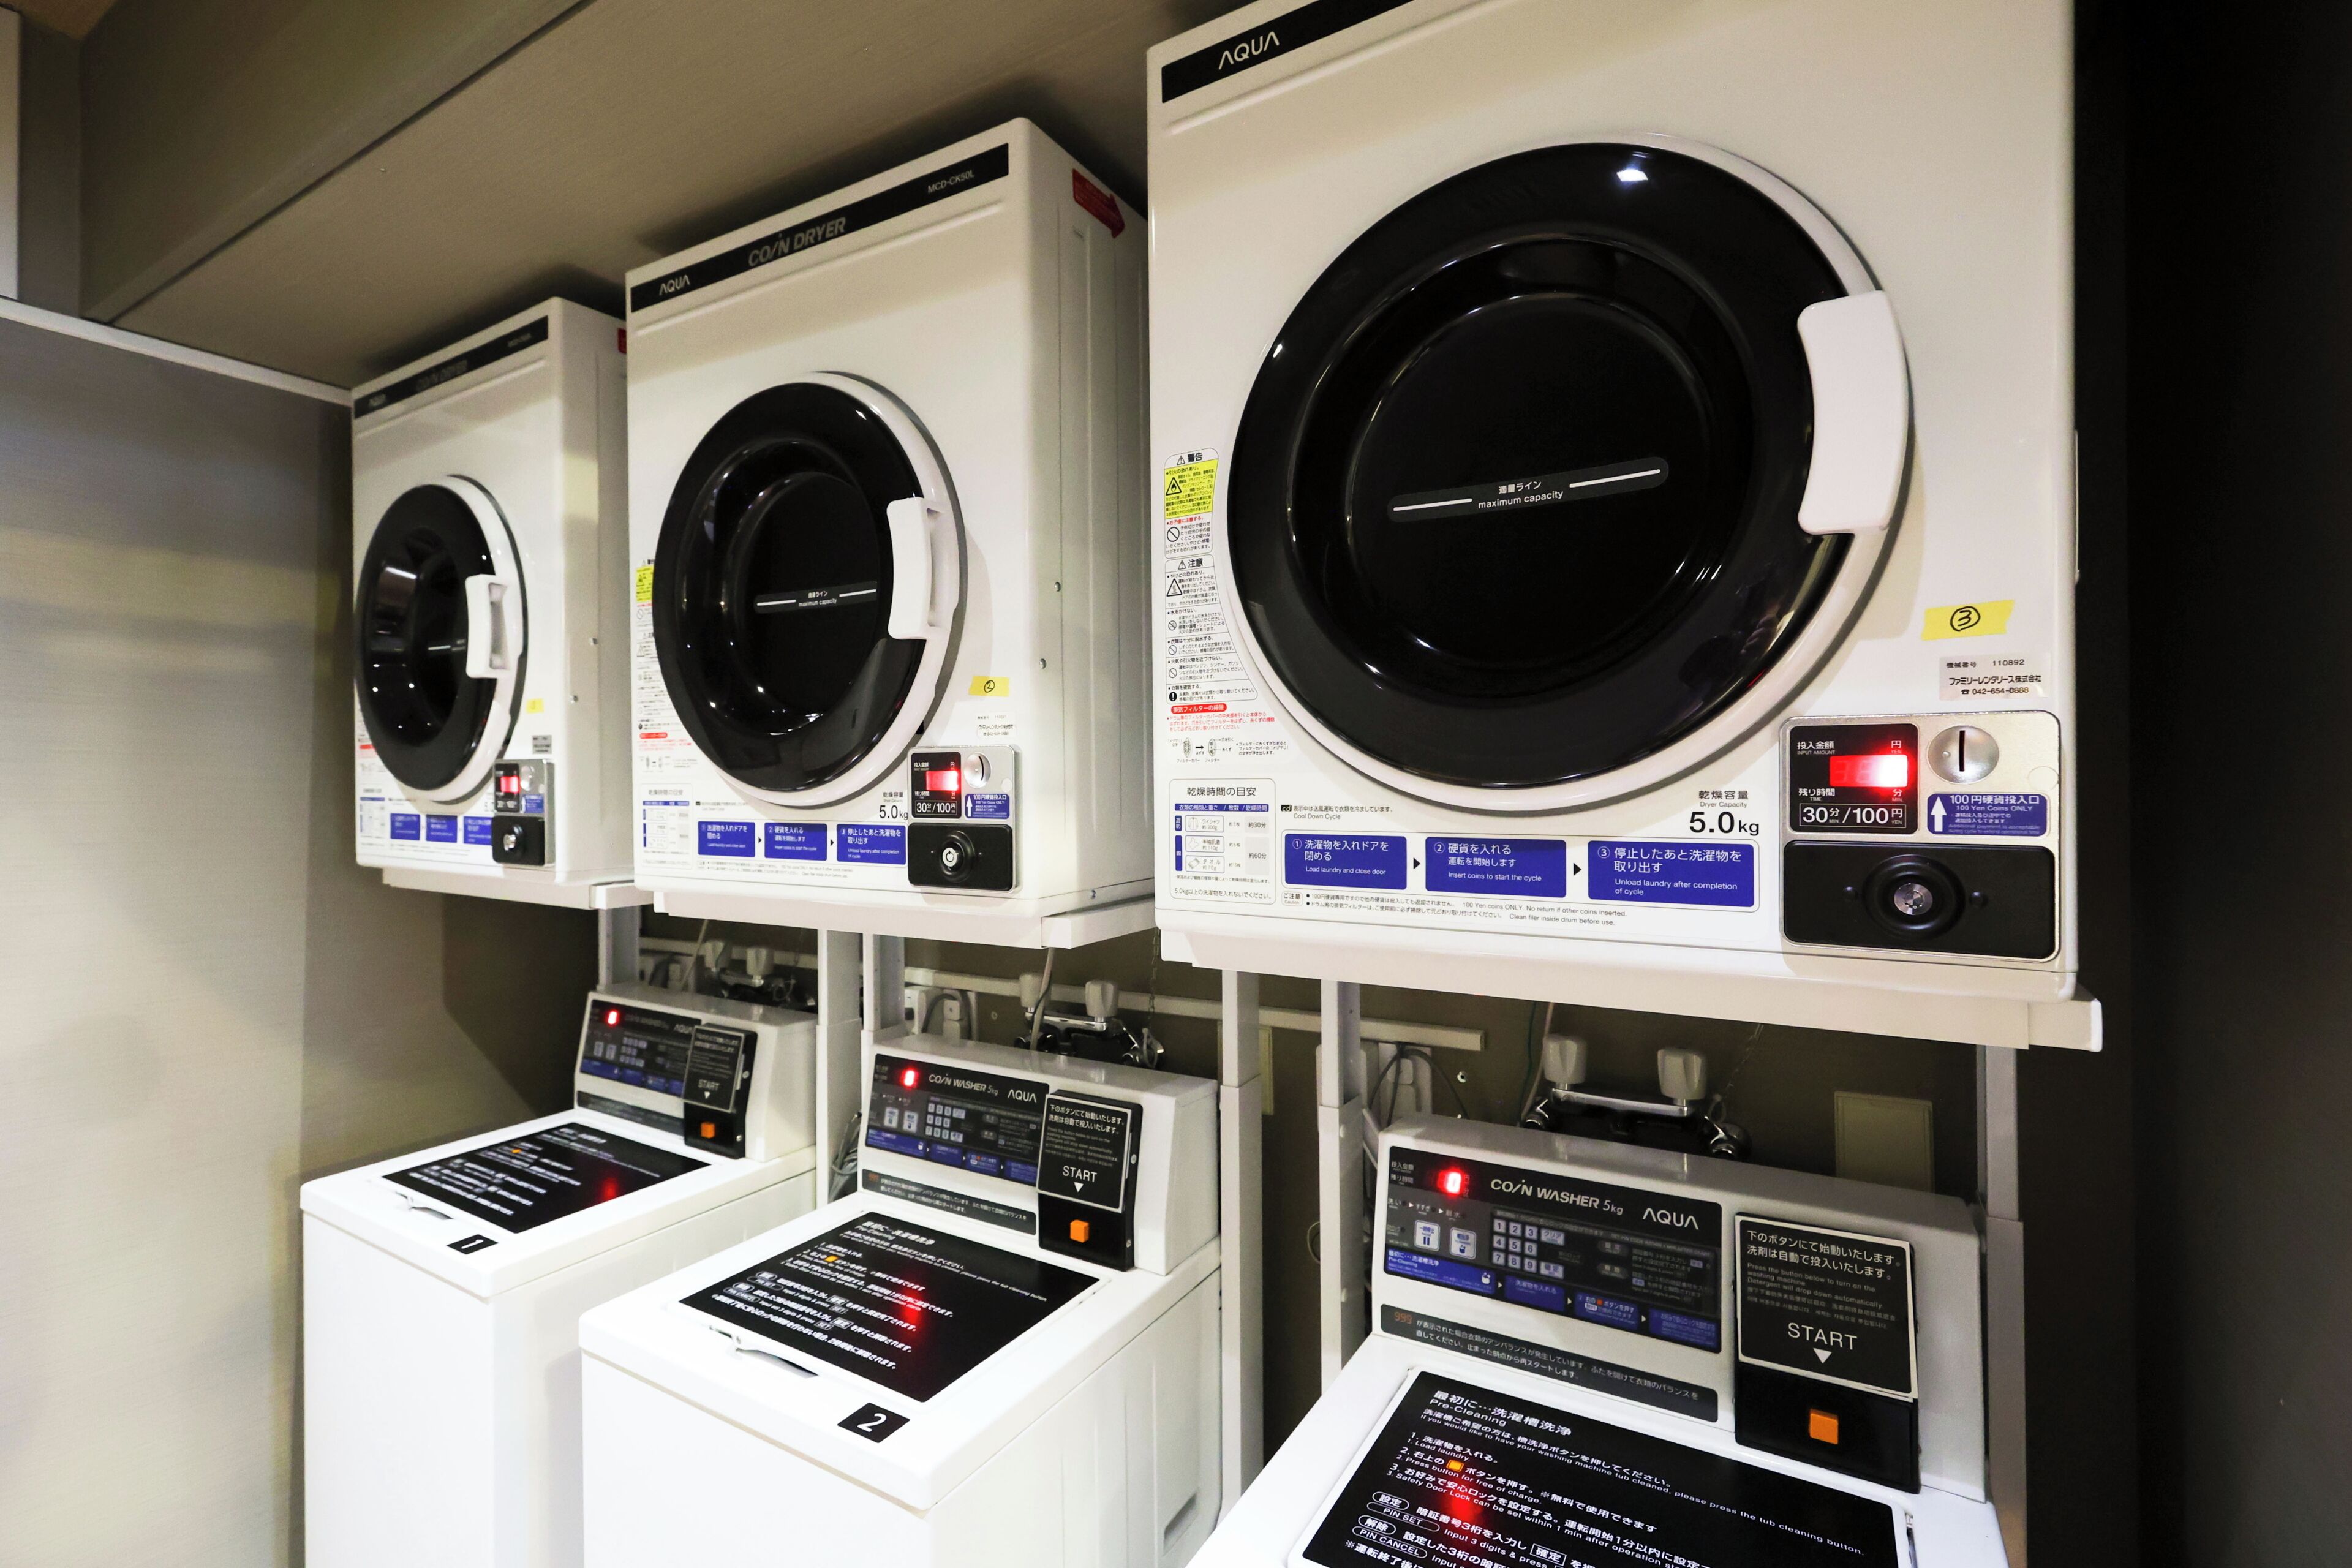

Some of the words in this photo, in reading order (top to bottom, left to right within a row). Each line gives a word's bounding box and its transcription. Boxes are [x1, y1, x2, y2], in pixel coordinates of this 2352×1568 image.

[1219, 31, 1280, 70] AQUA
[794, 217, 846, 251] DRYER
[658, 274, 690, 296] AQUA
[1188, 452, 1202, 462] 警告
[1499, 481, 1541, 494] 適量ライン
[1479, 496, 1521, 509] maximum
[1524, 490, 1564, 505] capacity
[1188, 558, 1203, 567] 注意
[1797, 741, 1834, 750] 投入金額
[1891, 740, 1901, 748] 円
[1187, 787, 1256, 796] 乾燥時間の目安
[1699, 791, 1749, 800] 乾燥容量
[1305, 840, 1389, 851] 洗濯物を入れドアを
[1449, 843, 1512, 854] 硬貨を入れる
[1305, 851, 1332, 861] 閉める
[1449, 857, 1516, 867] 運転を開始します
[1615, 848, 1742, 862] 停止したあと洗濯物を
[1614, 861, 1662, 873] 取り出す
[1693, 882, 1738, 891] completion
[698, 1079, 720, 1091] START
[954, 1079, 986, 1092] WASHER
[1008, 1089, 1036, 1103] AQUA
[1063, 1166, 1097, 1182] START
[1537, 1188, 1599, 1209] WASHER
[1603, 1200, 1623, 1215] 5kg
[1643, 1208, 1698, 1230] AQUA
[461, 1239, 484, 1249] 1
[1747, 1229, 1901, 1267] 下のボタンにて始動いたします。
[1747, 1244, 1891, 1280] 洗剤は自動で投入いたします。
[1788, 1322, 1858, 1350] START
[1430, 1398, 1507, 1427] Pre-Cleaning
[858, 1413, 886, 1432] 2
[1415, 1441, 1436, 1450] Load
[1422, 1436, 1498, 1463] 洗濯物を入れる。
[1405, 1457, 1430, 1468] Press
[1431, 1464, 1459, 1477] button
[1476, 1479, 1494, 1489] free
[1507, 1488, 1542, 1504] charge.
[1414, 1451, 1445, 1464] 右上の
[1465, 1467, 1533, 1493] ボタンを押す。
[1404, 1468, 1558, 1523] お好みで安心ロックを設定する。
[1444, 1422, 1468, 1431] would
[1495, 1436, 1515, 1446] have
[1517, 1443, 1536, 1452] your
[1537, 1449, 1572, 1464] washing
[1575, 1461, 1612, 1476] machine
[1675, 1491, 1706, 1505] please
[1709, 1502, 1737, 1515] press
[1740, 1511, 1756, 1520] the
[1760, 1518, 1776, 1526] tub
[1779, 1523, 1823, 1543] cleaning
[1827, 1539, 1864, 1556] button.
[1364, 1518, 1389, 1531] 解除
[1378, 1494, 1403, 1507] 設定
[1416, 1506, 1527, 1550] 暗証番号3桁を入力し
[1536, 1547, 1562, 1562] 確定
[1396, 1473, 1423, 1486] Safety
[1426, 1483, 1447, 1493] Door
[1450, 1491, 1471, 1501] Lock
[1473, 1498, 1490, 1508] can
[1525, 1517, 1552, 1529] within
[1564, 1528, 1582, 1539] min
[1586, 1536, 1609, 1547] after
[1611, 1545, 1661, 1566] operation
[1383, 1509, 1401, 1518] PIN
[1403, 1515, 1423, 1526] SET
[1444, 1529, 1468, 1542] Input
[1480, 1542, 1506, 1555] digits
[1359, 1529, 1377, 1539] PIN
[1379, 1537, 1420, 1556] CANCEL
